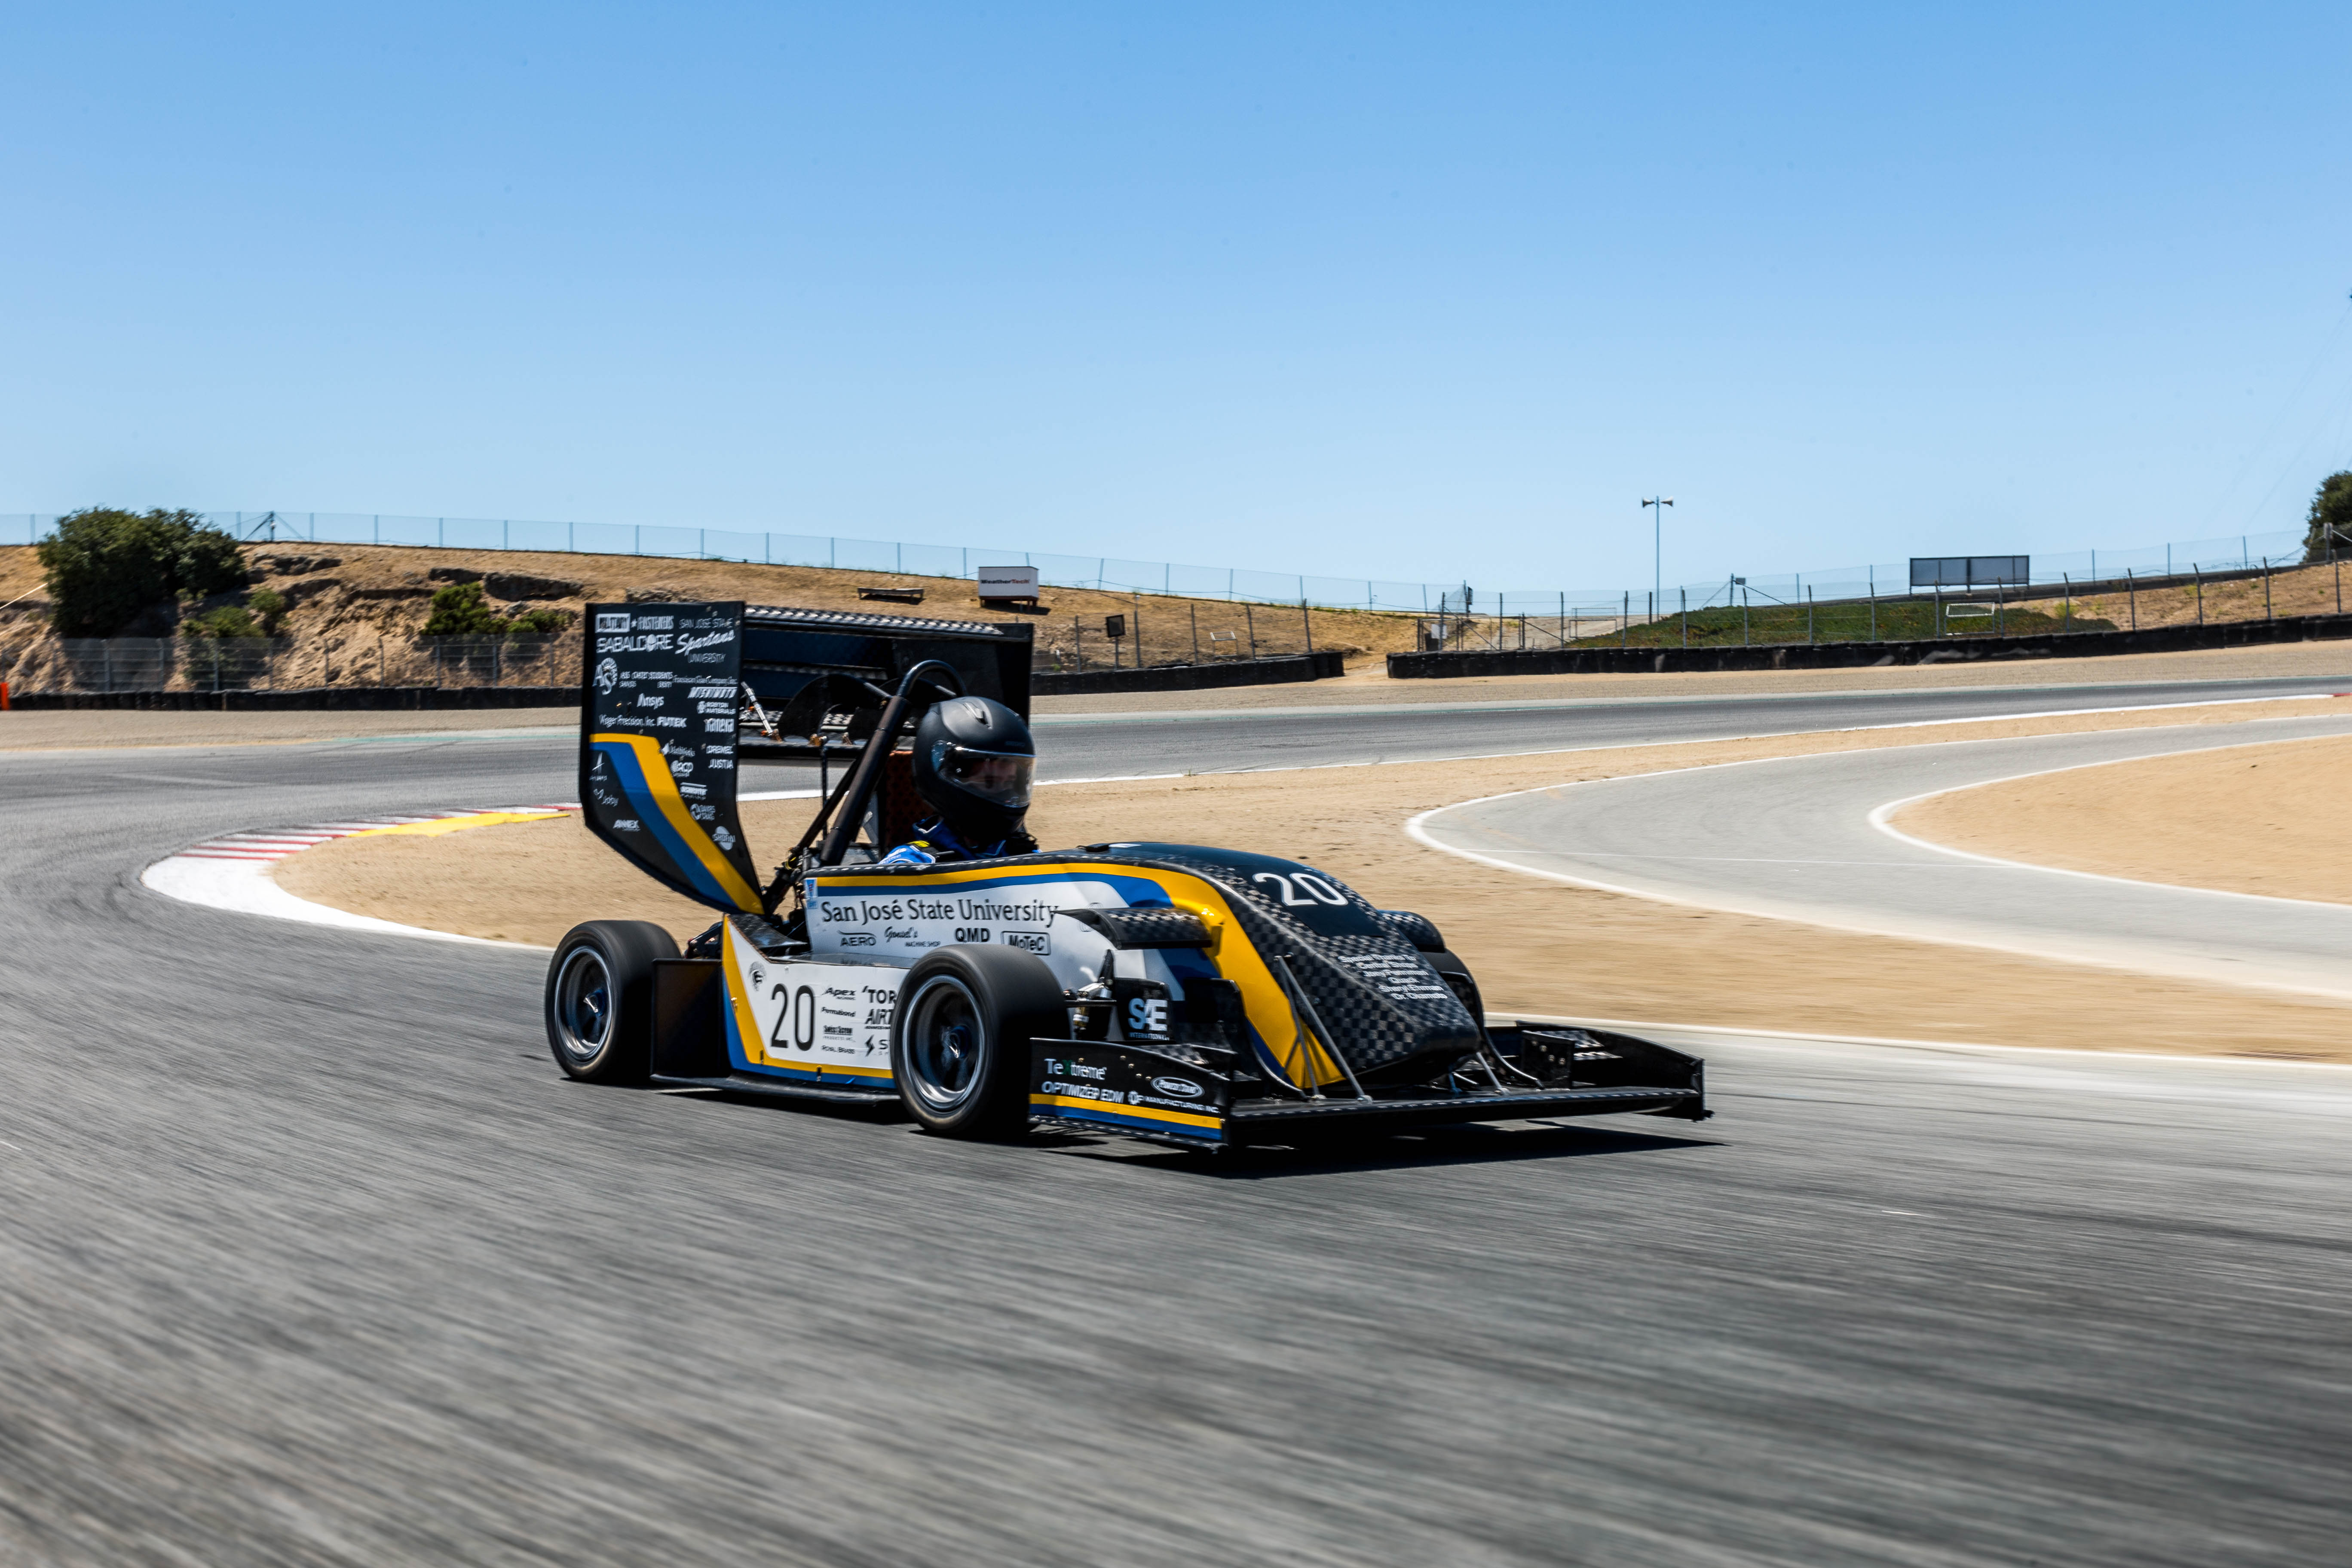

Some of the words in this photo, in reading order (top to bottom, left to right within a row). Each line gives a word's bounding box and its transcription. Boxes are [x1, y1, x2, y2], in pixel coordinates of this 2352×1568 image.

[596, 634, 674, 653] SABALCORE
[656, 716, 687, 728] FUTEK
[706, 745, 734, 754] DREMEL
[708, 759, 734, 769] JUSTIA
[1253, 873, 1348, 906] 20
[821, 901, 858, 922] San
[860, 899, 903, 925] José
[907, 898, 955, 920] State
[957, 898, 1059, 928] University
[840, 937, 877, 946] AERO
[955, 927, 990, 943] QMD
[1008, 935, 1045, 951] MoTeC
[822, 987, 856, 996] Apex
[771, 983, 815, 1051] 20
[1044, 1058, 1106, 1080] TeXtreme
[1041, 1081, 1099, 1099] OPTIMIZED
[1100, 1088, 1124, 1104] EDM
